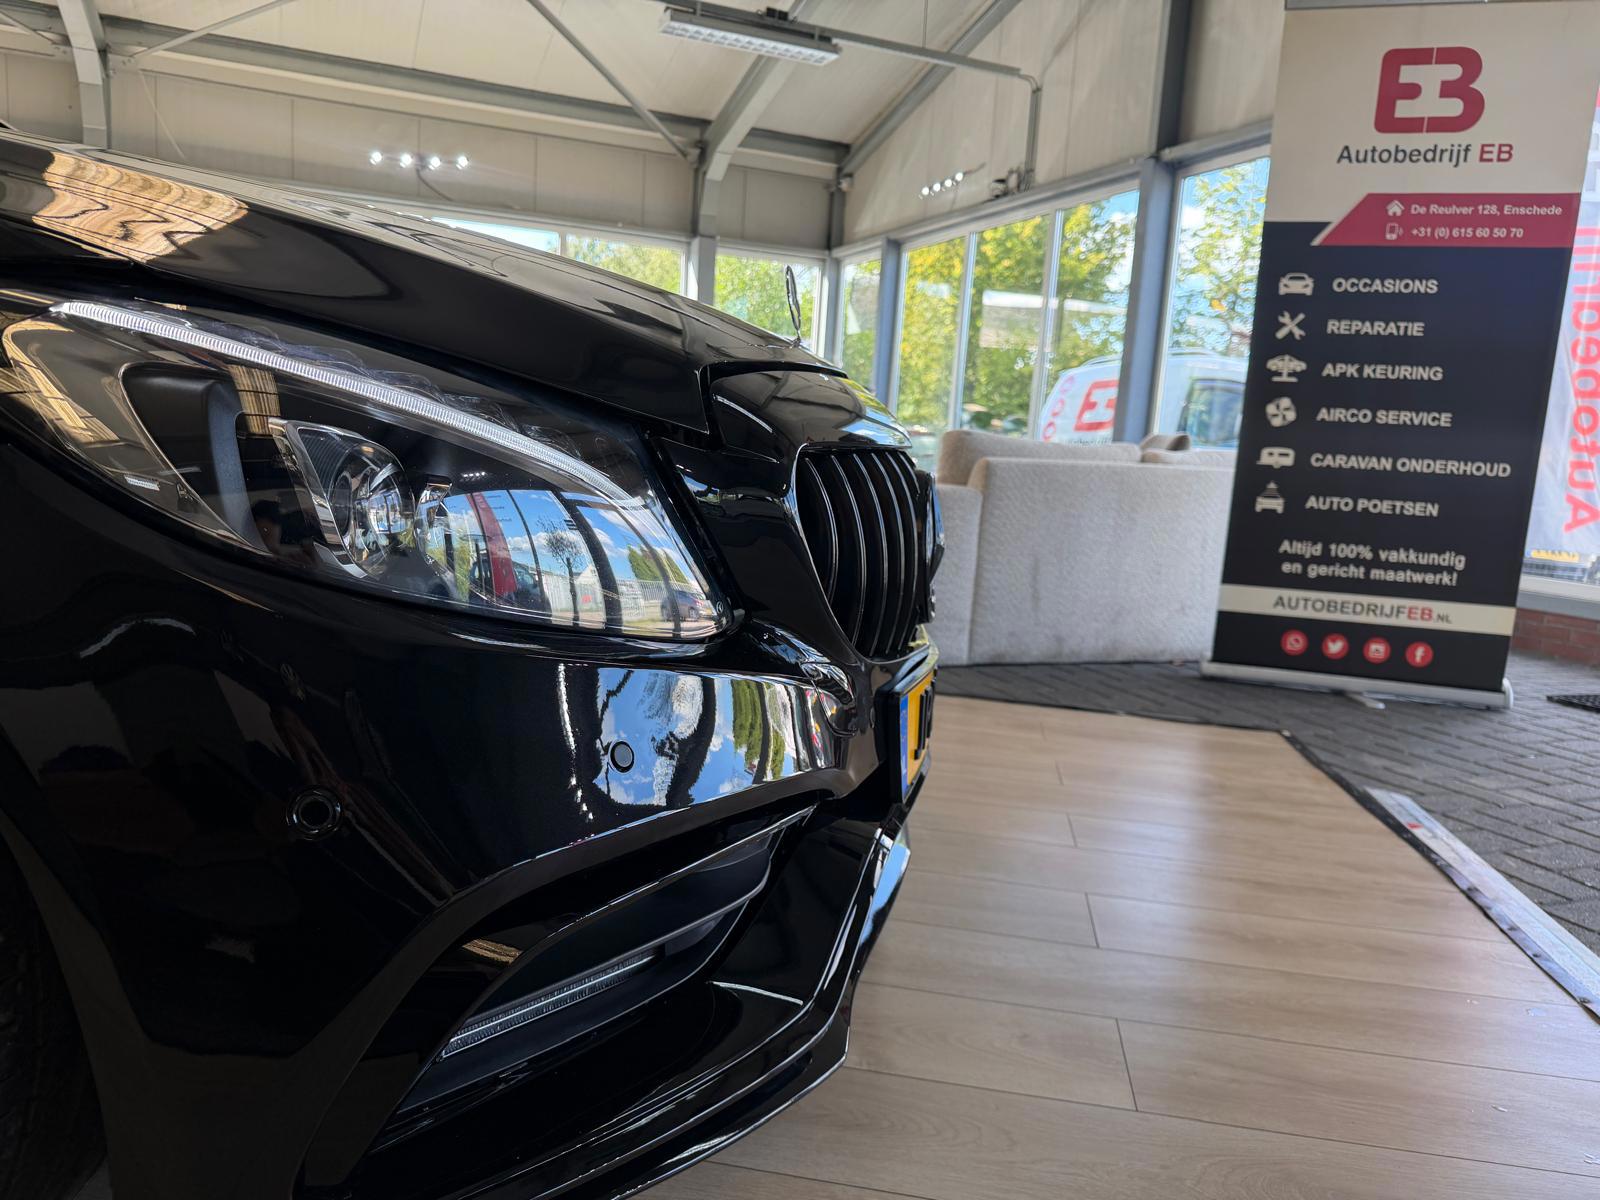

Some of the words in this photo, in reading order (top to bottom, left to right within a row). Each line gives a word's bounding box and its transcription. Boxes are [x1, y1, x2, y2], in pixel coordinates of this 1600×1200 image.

[1336, 144, 1472, 168] Autobedrijf
[1478, 143, 1514, 163] EB
[1411, 204, 1427, 216] De
[1477, 204, 1500, 217] 128,
[1503, 204, 1563, 216] Enschede
[1411, 227, 1431, 238] +31
[1434, 227, 1450, 239] (0)
[1452, 227, 1473, 238] 615
[1475, 227, 1490, 238] 60
[1492, 227, 1507, 238] 50
[1510, 227, 1524, 238] 70
[1332, 277, 1439, 295] OCCASIONS
[1326, 319, 1425, 337] REPARATIE
[1321, 362, 1359, 379] APK
[1362, 364, 1444, 382] KEURING
[1316, 407, 1372, 425] AIRCO
[1375, 409, 1453, 427] SERVICE
[1310, 453, 1393, 472] CARAVAN
[1396, 457, 1512, 478] ONDERHOUD
[1305, 495, 1354, 512] AUTO
[1357, 499, 1440, 517] POETSEN
[1278, 539, 1322, 559] Altijd
[1329, 543, 1373, 560] 100%
[1378, 548, 1466, 571] vakkundig
[1281, 562, 1302, 574] en
[1307, 562, 1365, 579] gericht
[1370, 567, 1457, 587] maatwerk!
